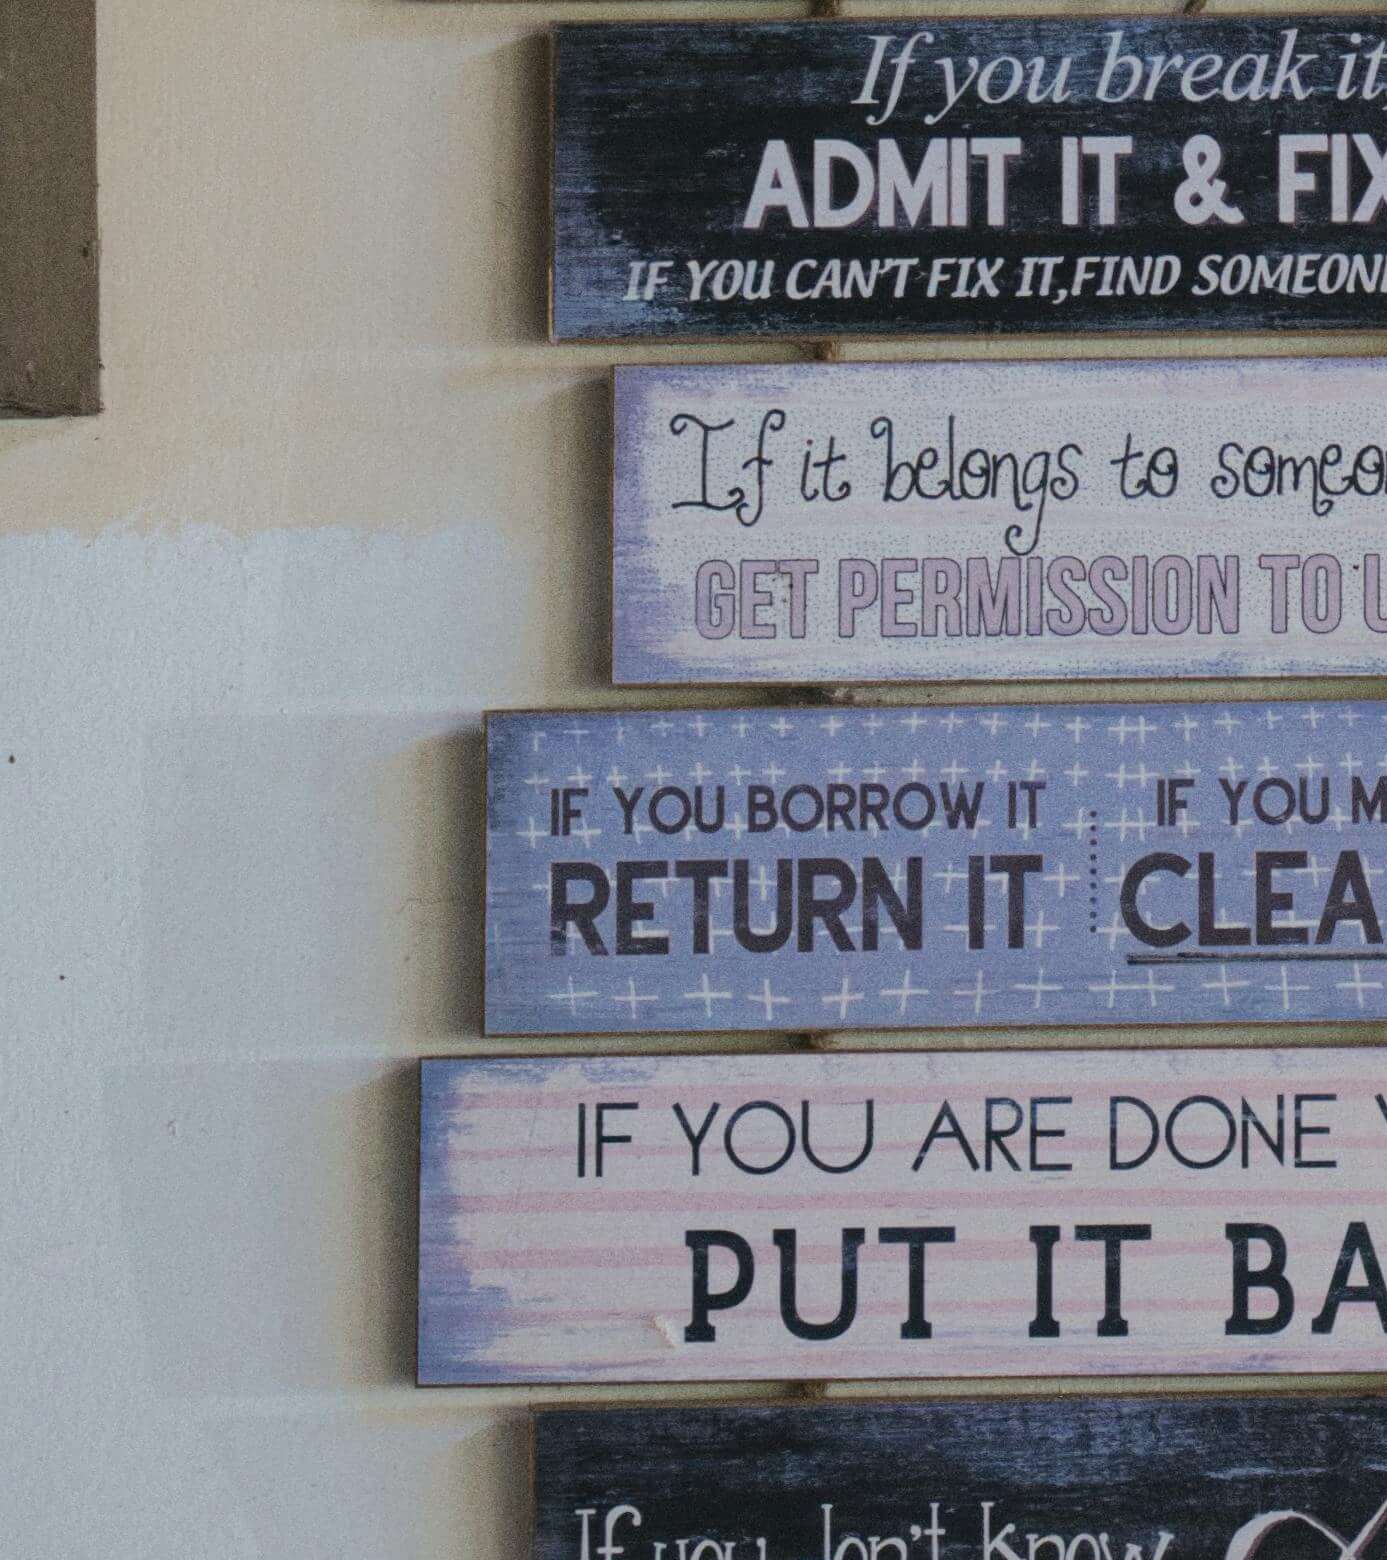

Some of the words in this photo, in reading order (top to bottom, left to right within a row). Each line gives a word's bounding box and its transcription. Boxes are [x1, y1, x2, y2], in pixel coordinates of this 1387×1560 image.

[851, 35, 919, 125] If
[926, 49, 1073, 126] you
[1096, 34, 1316, 107] break
[743, 136, 1022, 230] ADMIT
[1061, 136, 1132, 228] IT
[1173, 134, 1245, 227] &
[621, 261, 675, 304] IF
[685, 259, 781, 303] YOU
[784, 257, 920, 301] CAN'T
[924, 259, 1001, 300] FIX
[668, 411, 787, 528] If
[798, 435, 854, 503] it
[871, 415, 1082, 559] belongs
[1110, 434, 1179, 501] to
[694, 558, 809, 642] GET
[837, 554, 1243, 641] PERMISSION
[1259, 552, 1342, 635] TO
[549, 787, 589, 835] IF
[610, 785, 726, 837] YOU
[745, 783, 985, 834] BORROW
[1002, 780, 1047, 831] IT
[1155, 778, 1199, 828] IF
[1217, 776, 1340, 828] YOU
[549, 857, 925, 959] RETURN
[964, 855, 1045, 952] IT
[575, 1101, 641, 1179] IF
[672, 1098, 875, 1177] YOU
[909, 1097, 1075, 1173] ARE
[1108, 1093, 1340, 1172] DONE
[682, 1225, 957, 1343] PUT
[1026, 1223, 1152, 1340] IT
